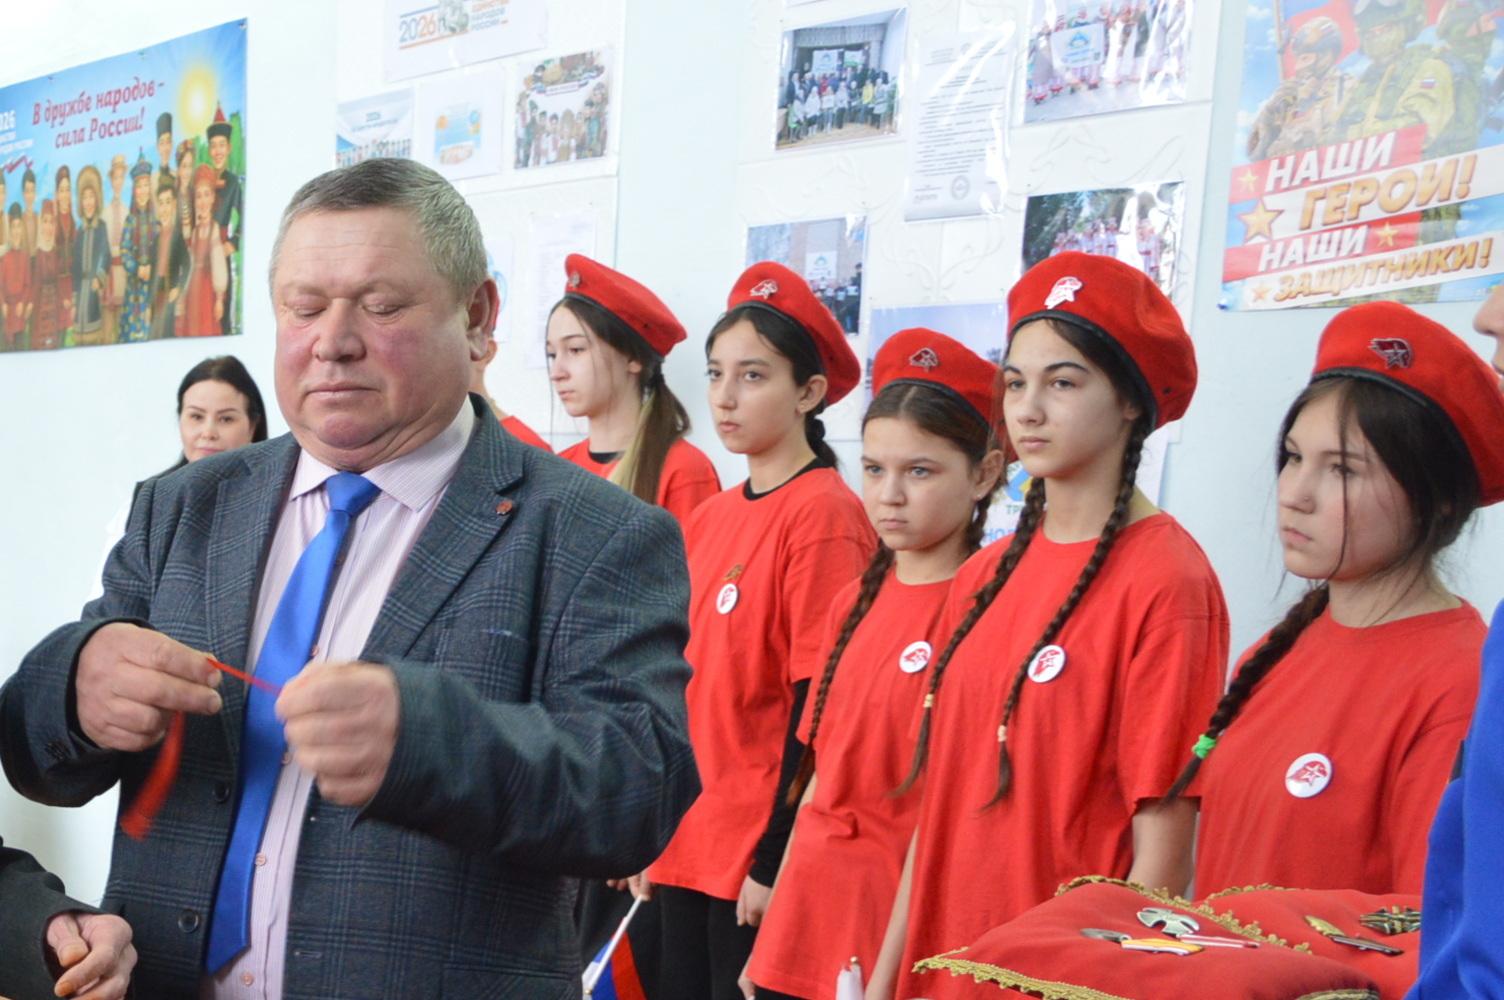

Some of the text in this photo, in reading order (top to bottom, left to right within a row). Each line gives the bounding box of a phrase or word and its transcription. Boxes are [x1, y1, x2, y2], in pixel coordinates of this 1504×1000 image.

[399, 13, 437, 43] 2026
[32, 102, 41, 126] В
[44, 90, 92, 128] дружбе
[96, 76, 155, 113] народов
[55, 106, 145, 148] сила России!
[1264, 131, 1396, 192] НАШИ
[1299, 154, 1478, 231] ГЕРОИ!
[1258, 225, 1370, 272] НАШИ
[1274, 238, 1494, 302] ЗАЩИТНИКИ!
